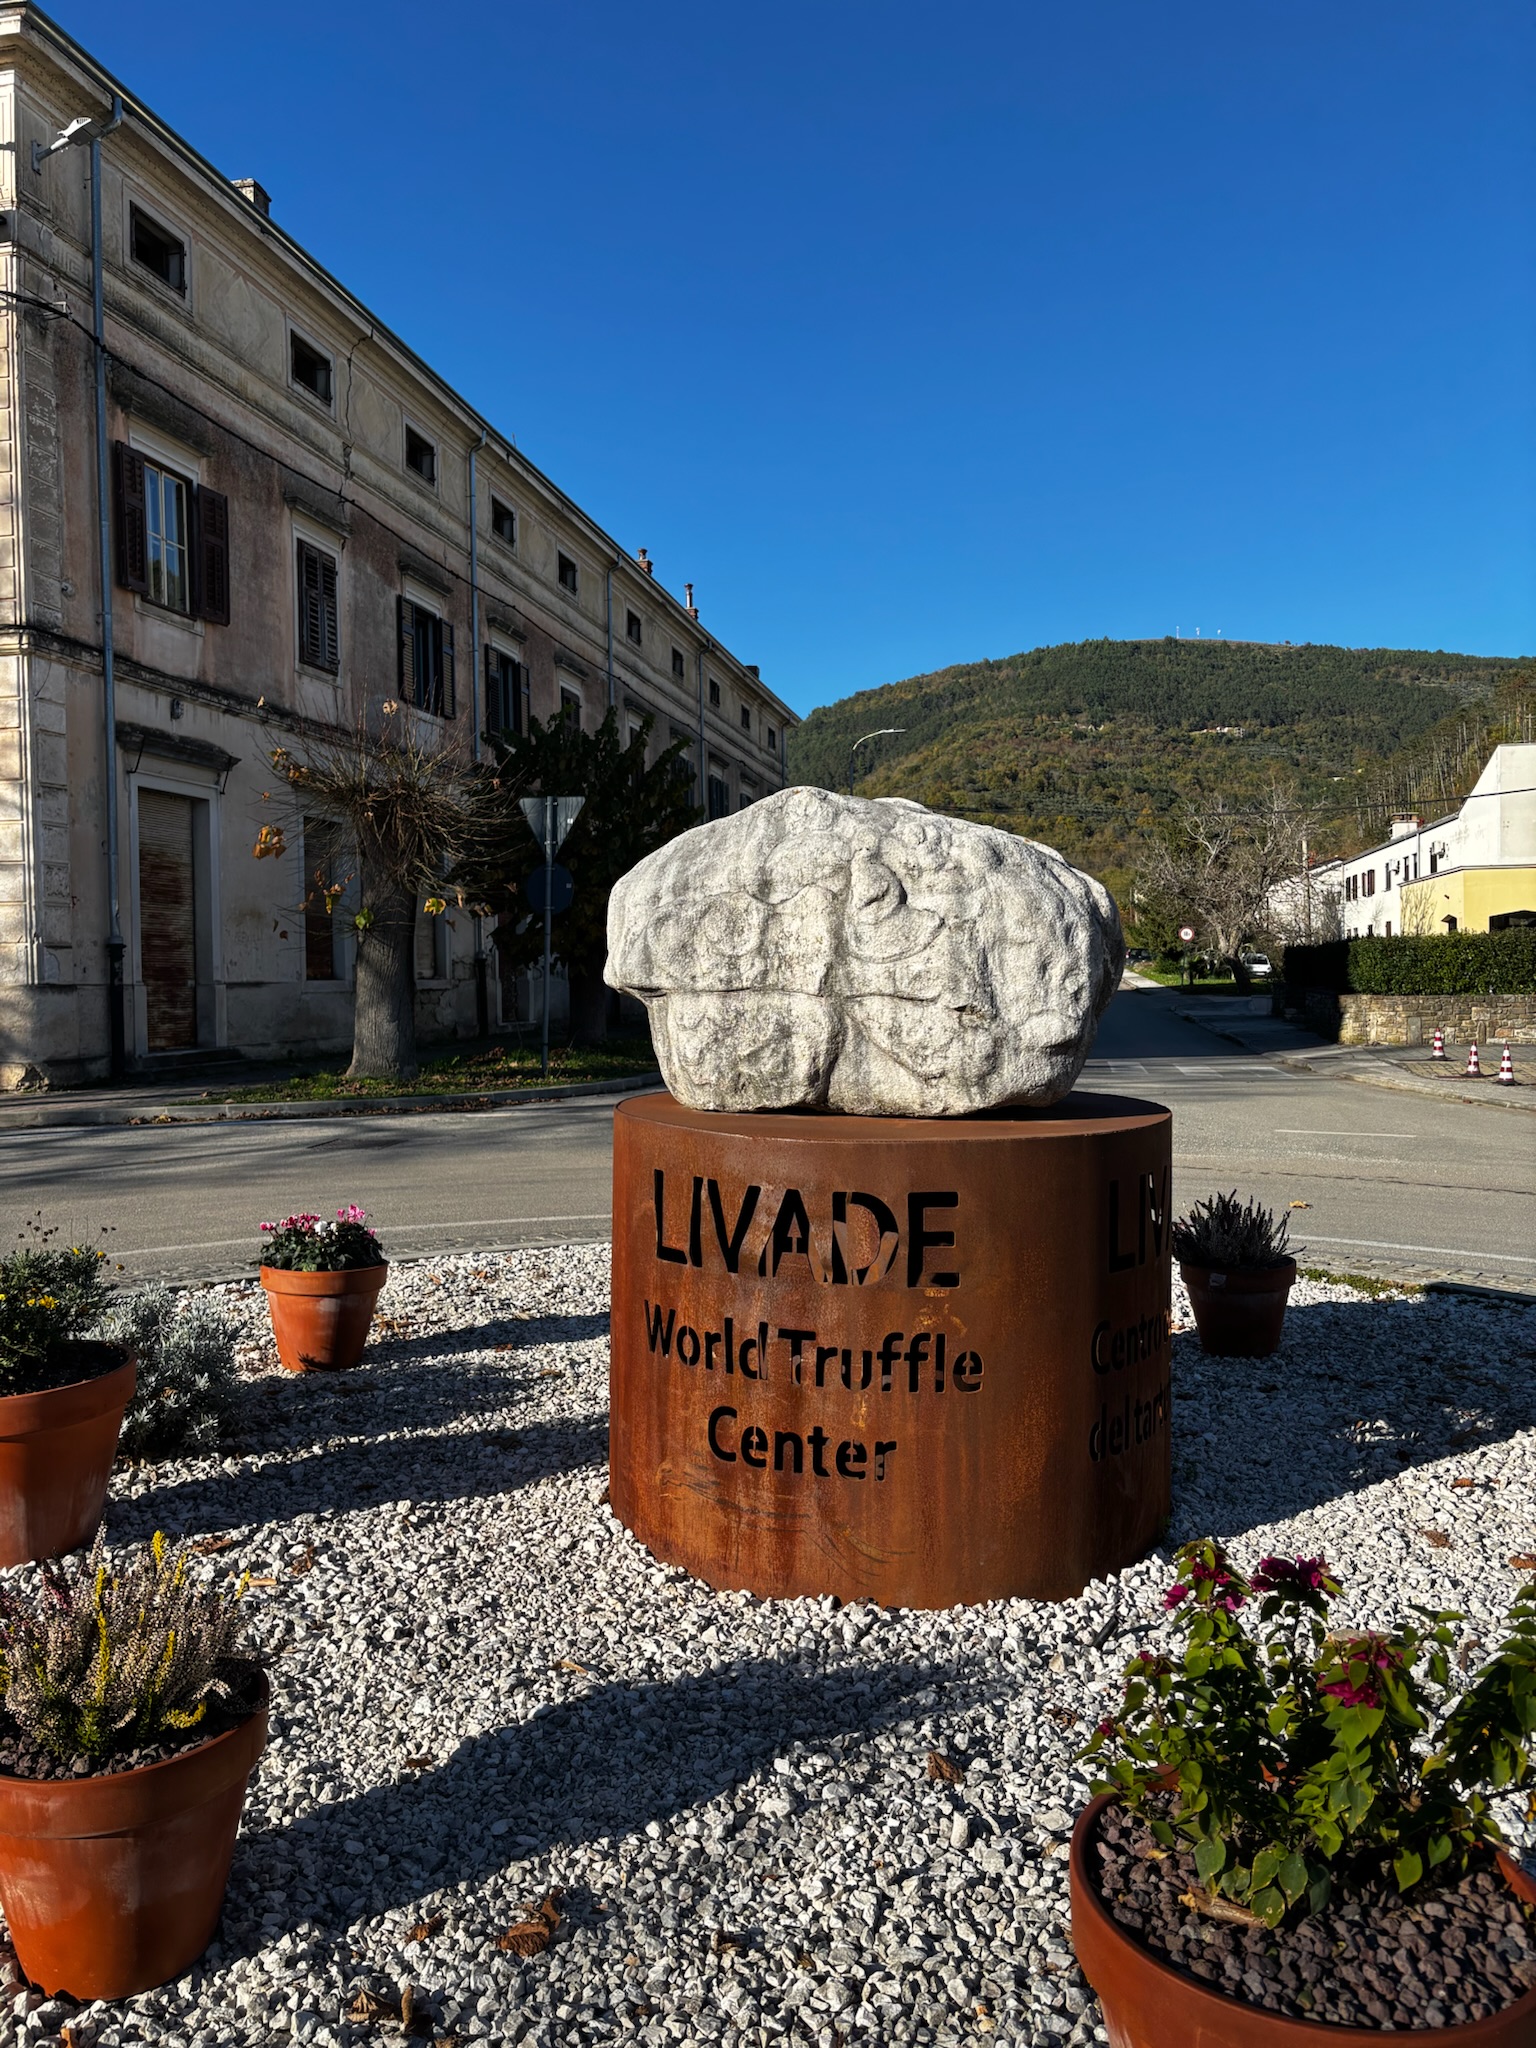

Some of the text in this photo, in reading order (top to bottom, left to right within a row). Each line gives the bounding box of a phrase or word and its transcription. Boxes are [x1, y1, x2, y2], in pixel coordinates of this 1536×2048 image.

[654, 1169, 961, 1289] LIVADE
[644, 1299, 985, 1394] World Truffle
[1091, 1312, 1162, 1375] Centro
[707, 1406, 897, 1482] Center
[1089, 1393, 1130, 1462] del
